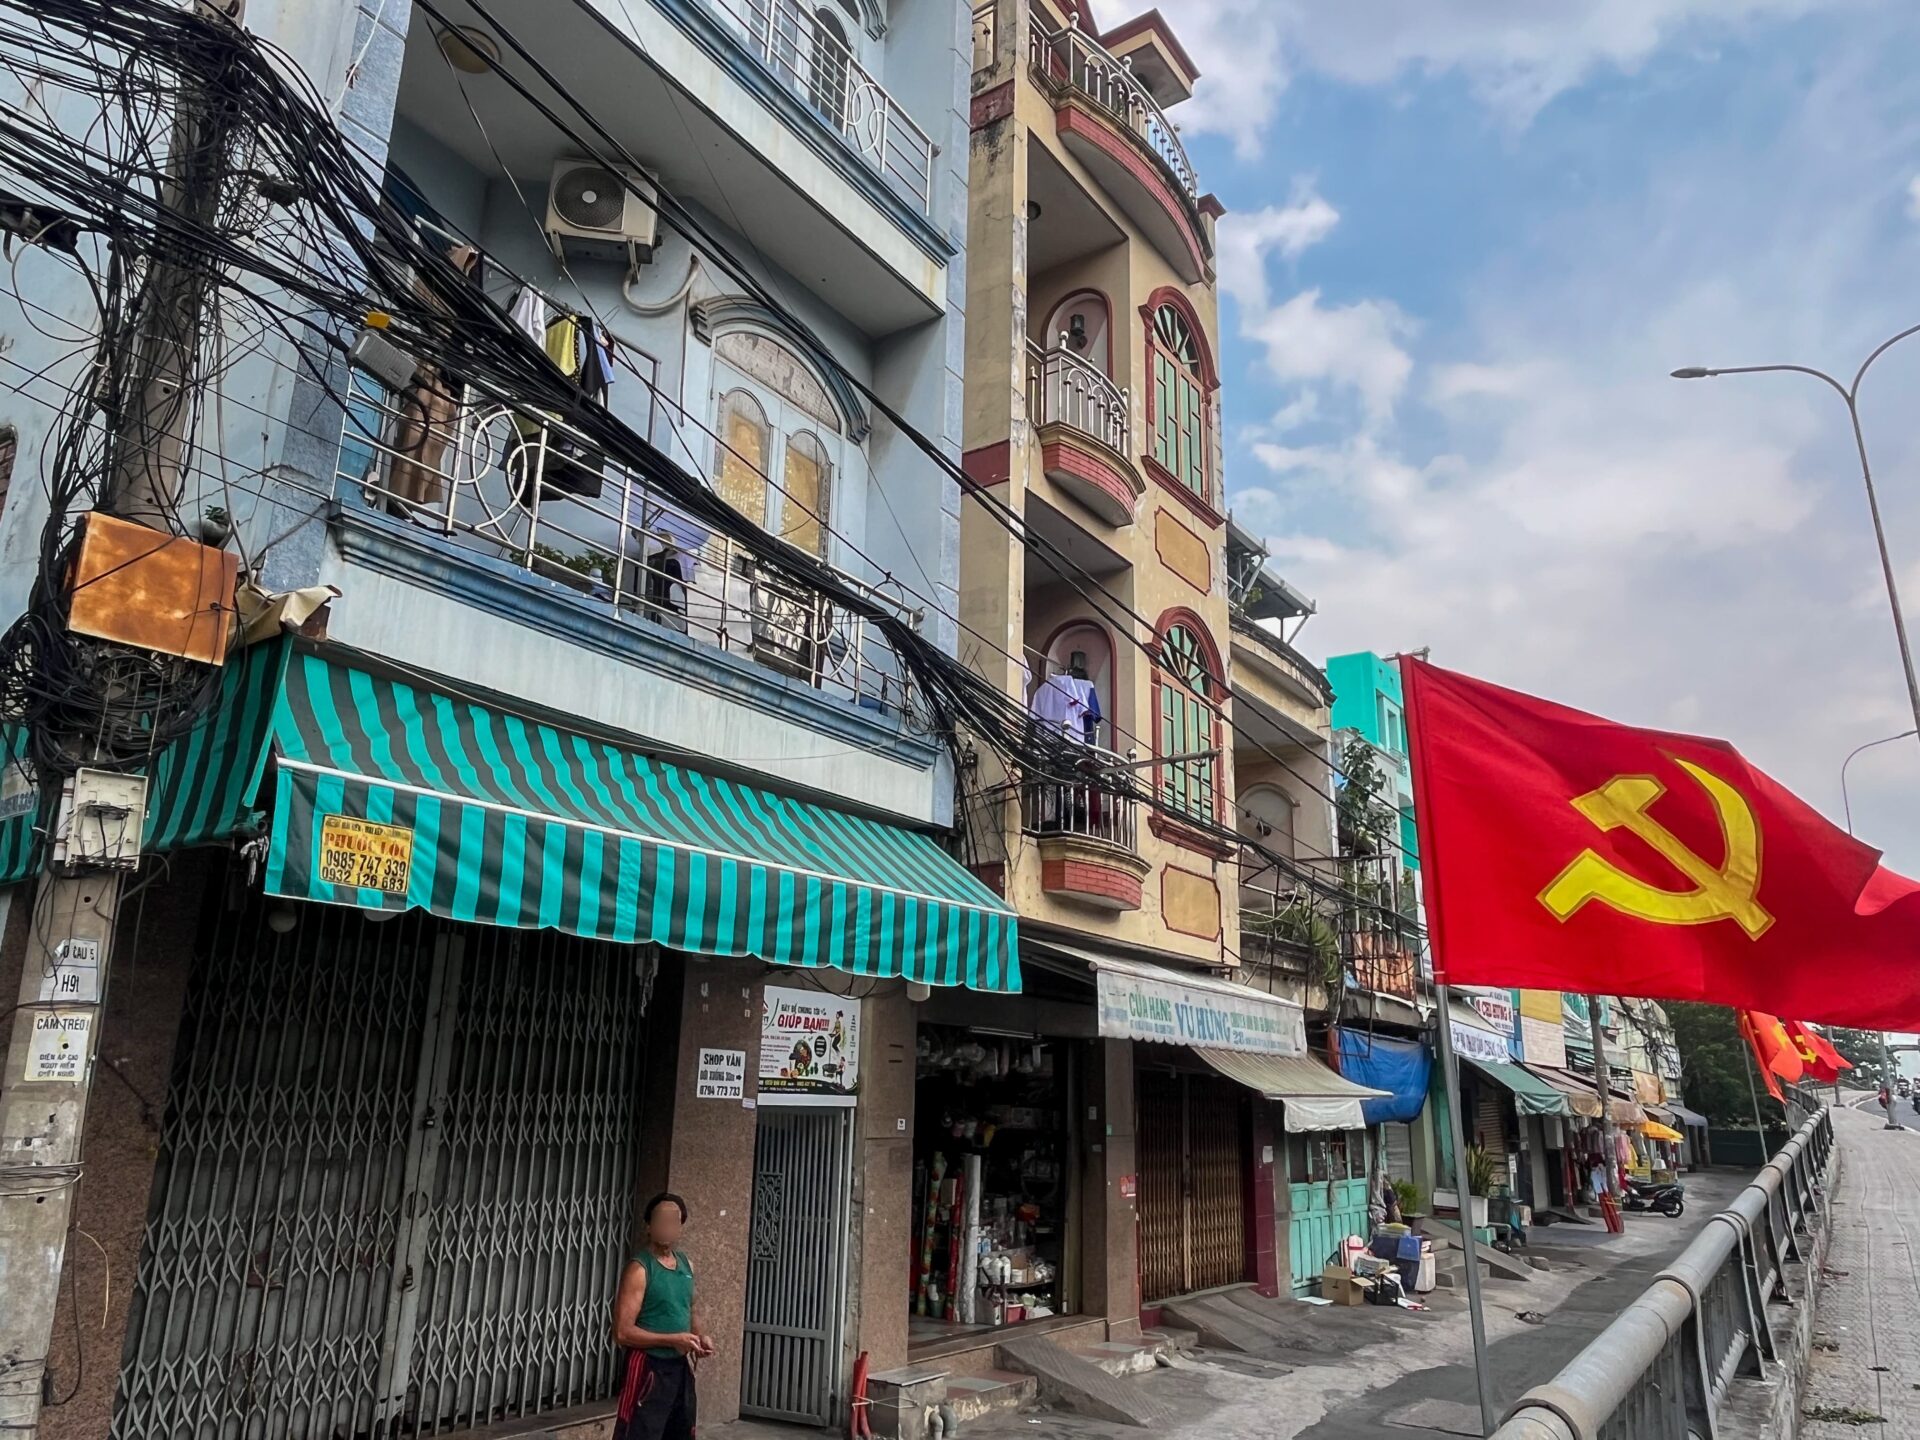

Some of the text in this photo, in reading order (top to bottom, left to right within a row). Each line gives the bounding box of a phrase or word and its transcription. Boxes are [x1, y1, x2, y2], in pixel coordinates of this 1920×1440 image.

[326, 849, 406, 878] 0985 747 339
[322, 866, 404, 892] 0932 126 683
[61, 974, 80, 993] H91
[37, 1014, 60, 1030] CẤM
[777, 1013, 802, 1029] GIÚP
[704, 1053, 724, 1065] SHOP
